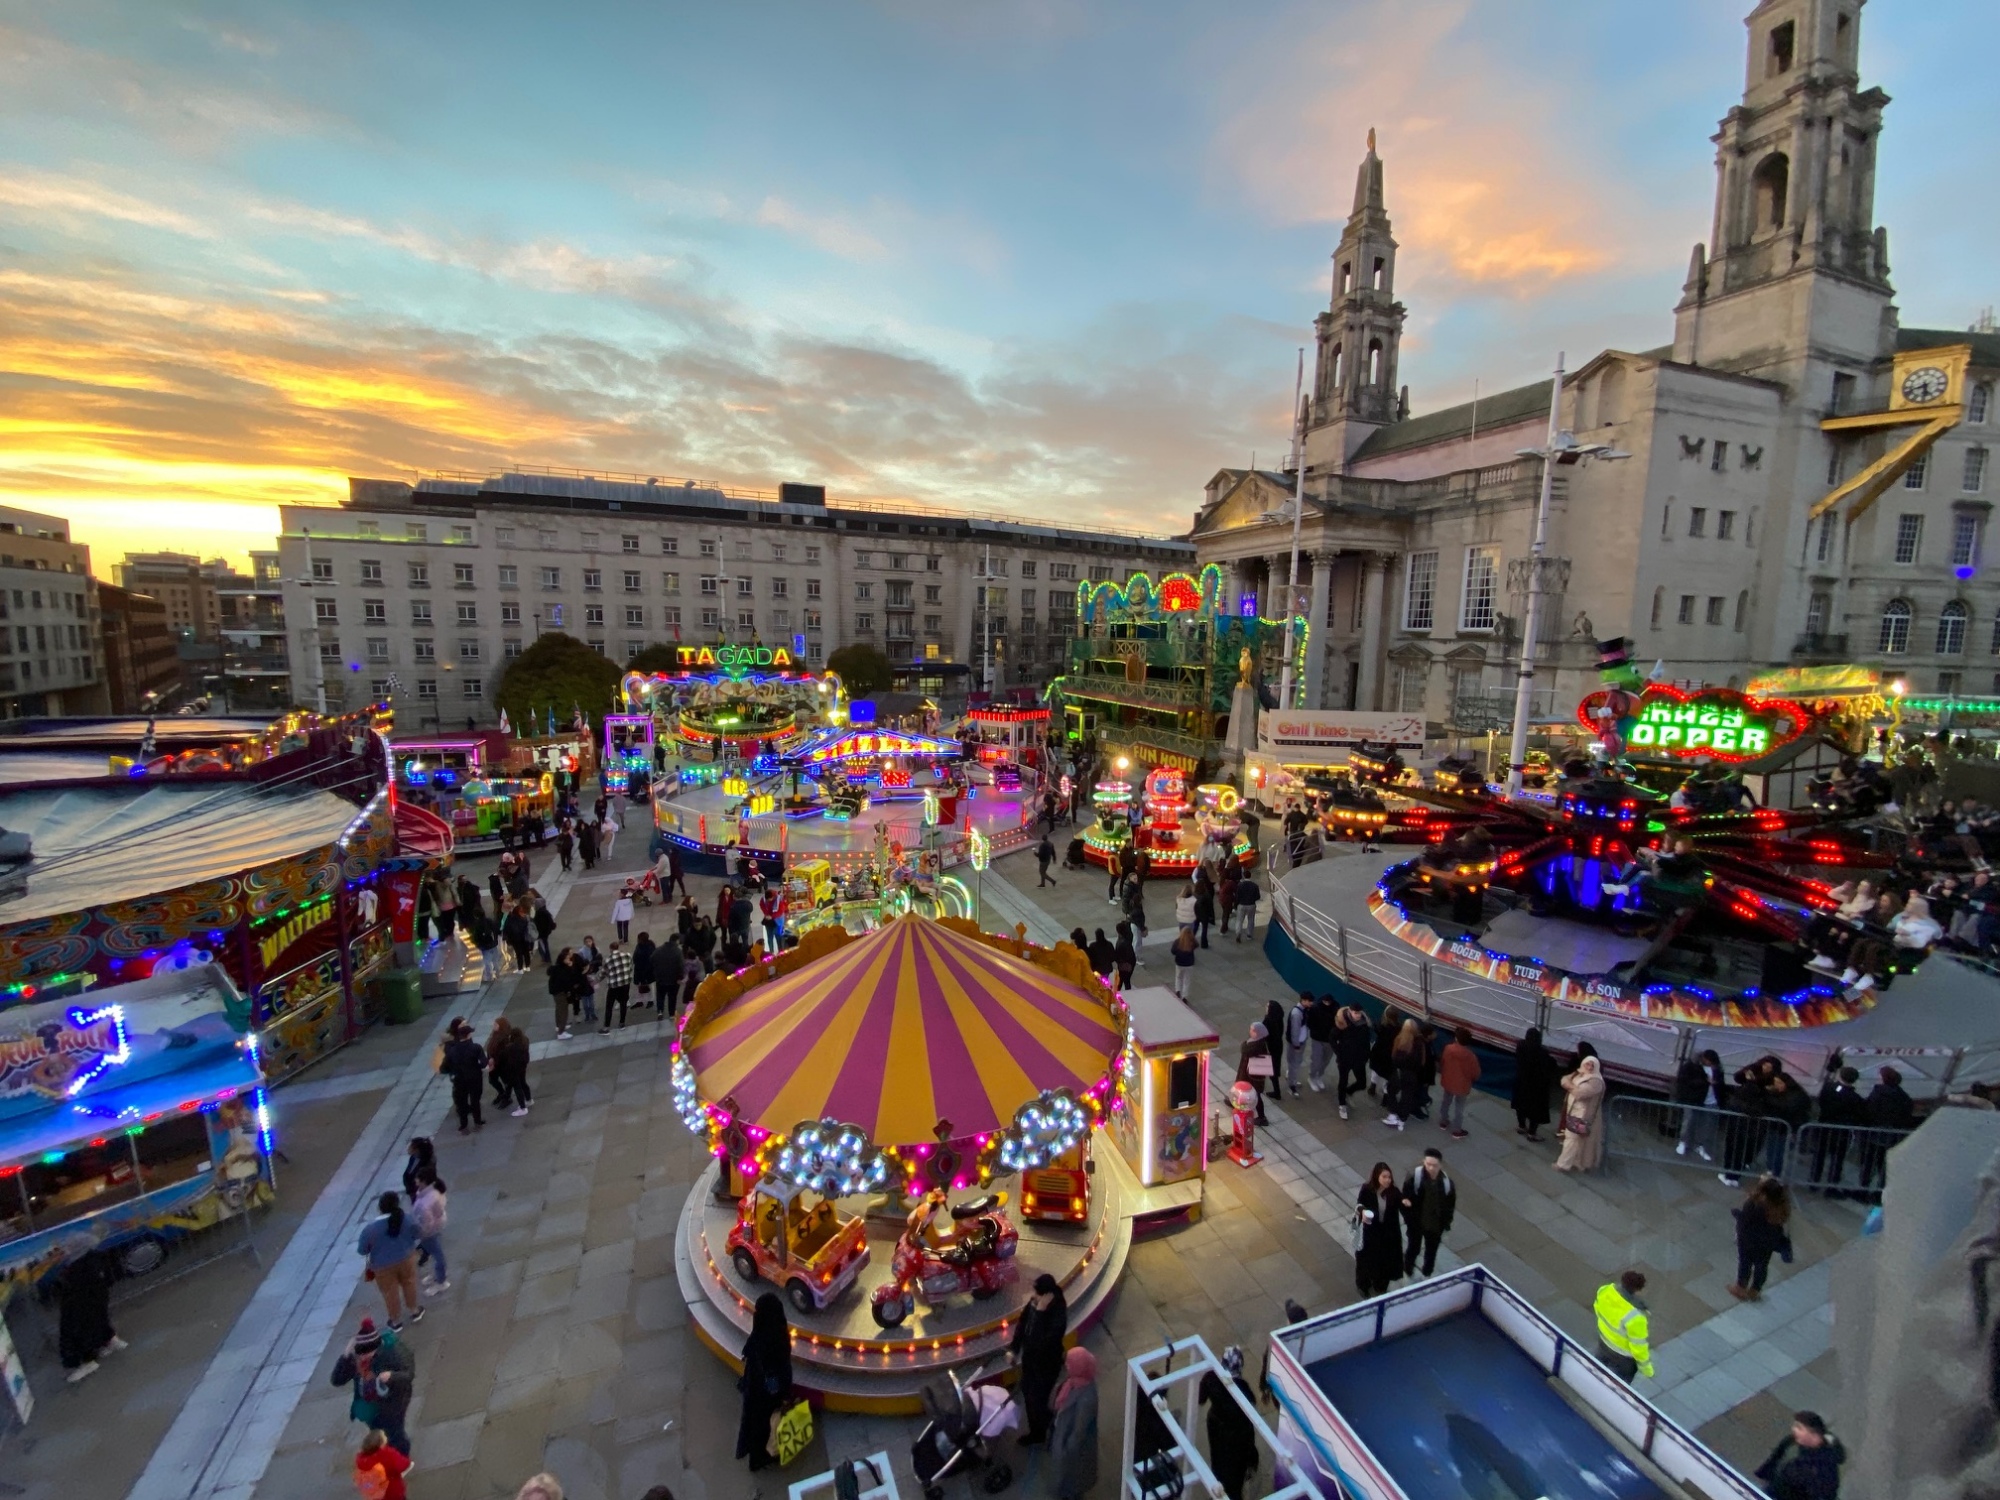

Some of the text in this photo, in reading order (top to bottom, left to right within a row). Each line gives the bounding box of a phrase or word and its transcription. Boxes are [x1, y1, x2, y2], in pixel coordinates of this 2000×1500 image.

[677, 647, 791, 665] TAGADA
[1278, 721, 1310, 737] Grill
[1312, 721, 1348, 738] Time
[1632, 723, 1768, 752] OPPER
[1133, 745, 1158, 763] FUN
[260, 901, 332, 969] WALTZER
[1450, 942, 1481, 962] ROGER
[1514, 964, 1542, 981] TUBY
[1507, 976, 1544, 992] funfairs
[1586, 981, 1622, 999] & SON
